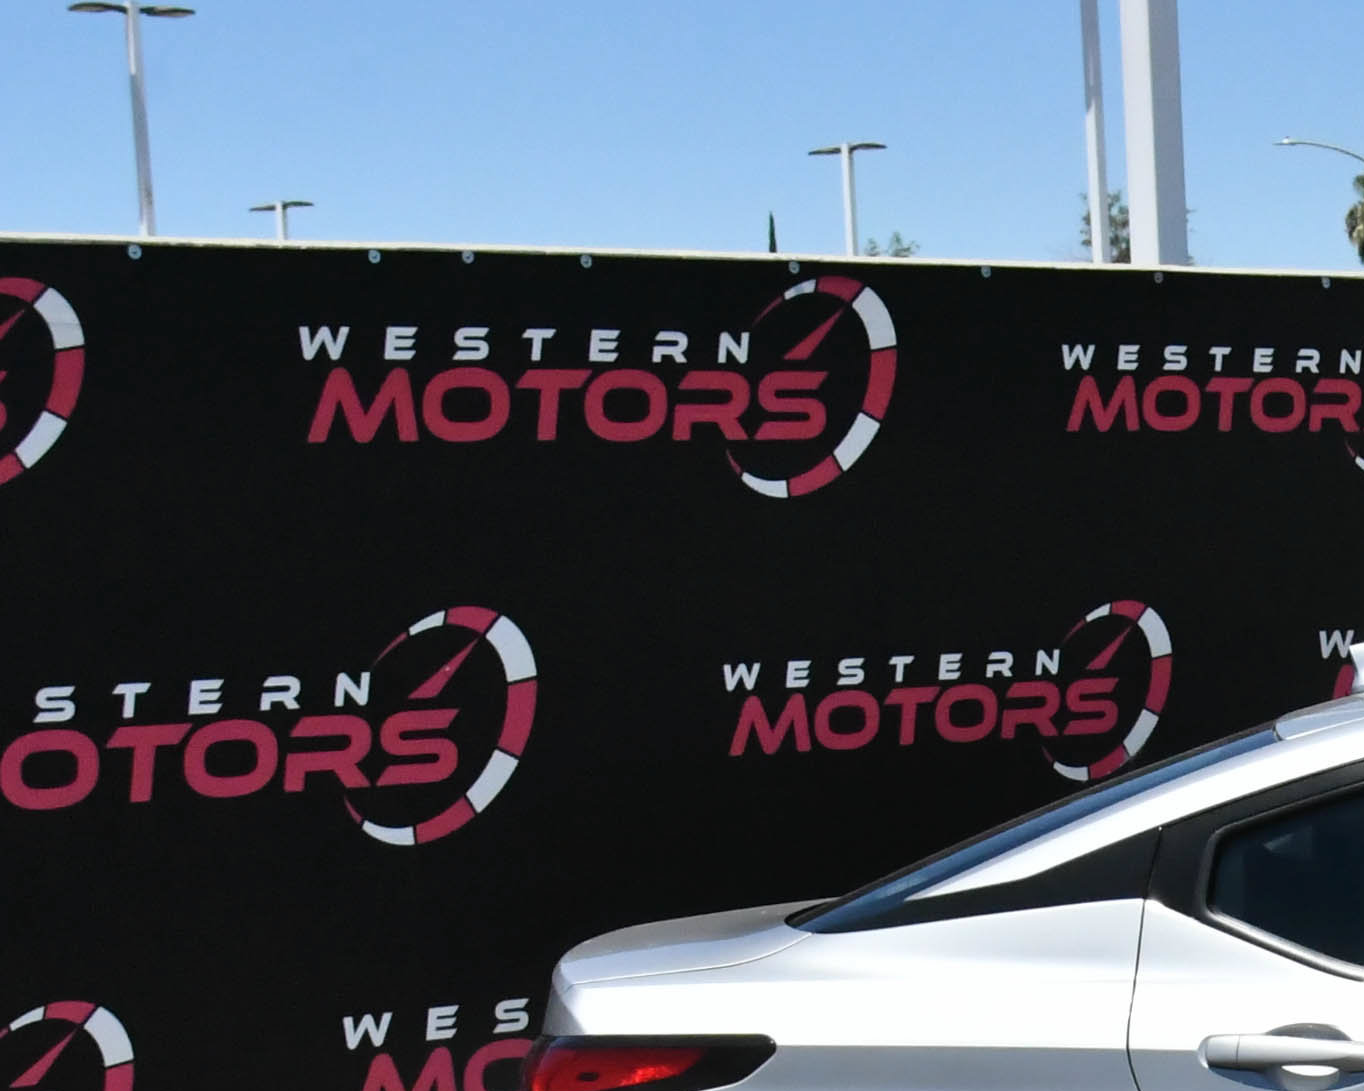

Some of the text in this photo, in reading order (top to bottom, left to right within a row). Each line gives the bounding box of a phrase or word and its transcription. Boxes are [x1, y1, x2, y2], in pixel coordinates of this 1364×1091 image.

[299, 326, 750, 364] WESTERN
[1062, 344, 1362, 375] WESTERN
[309, 367, 828, 443] MOTORS
[723, 648, 1060, 692] WESTERN
[33, 671, 371, 724] STERN
[730, 677, 1119, 756] MOTORS
[0, 708, 459, 811] OTORS
[343, 998, 529, 1051] WES
